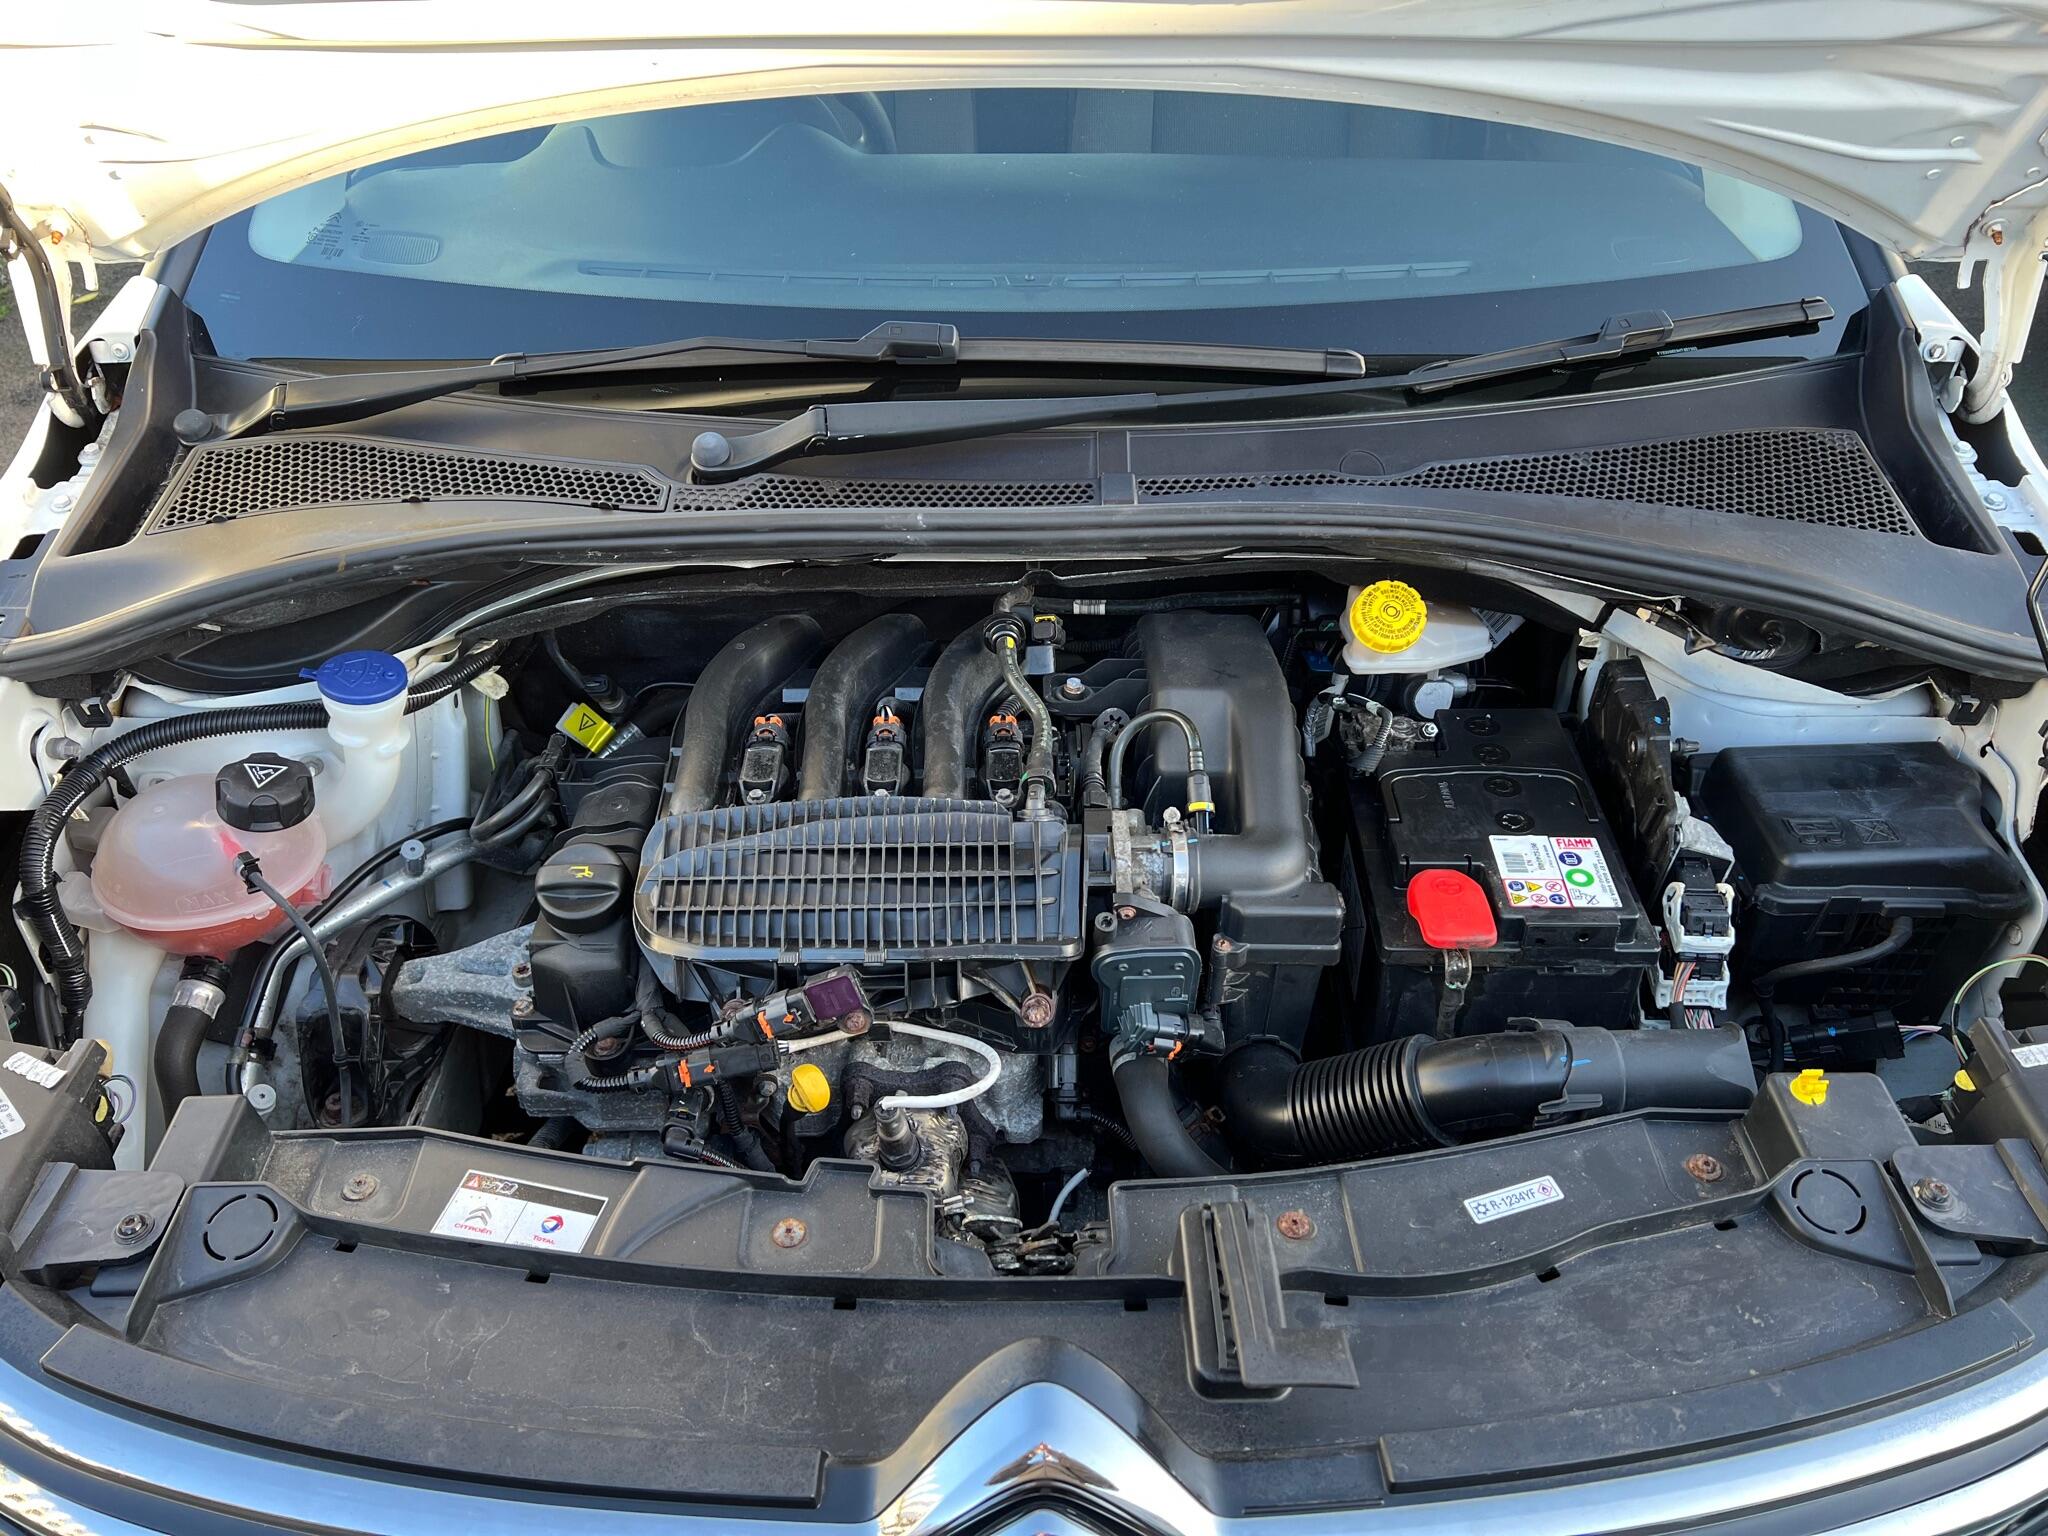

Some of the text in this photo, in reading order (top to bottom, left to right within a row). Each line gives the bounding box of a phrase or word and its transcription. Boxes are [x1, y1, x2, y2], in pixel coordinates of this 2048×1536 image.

[1556, 838, 1593, 848] FIAMM
[1489, 1188, 1536, 1210] R-1234YF
[454, 1222, 493, 1235] CITROËN
[532, 1234, 556, 1245] TOTAL
